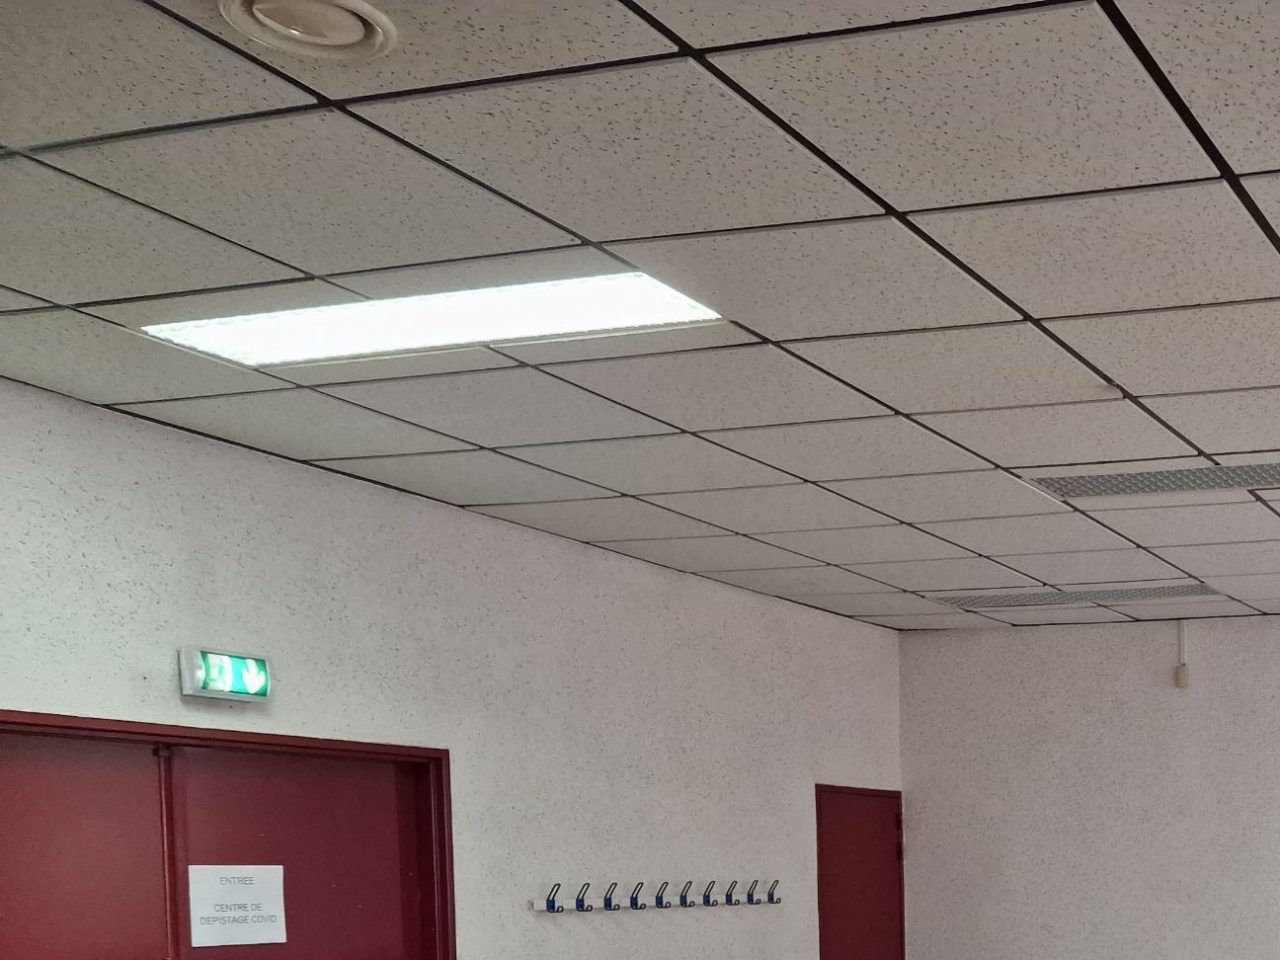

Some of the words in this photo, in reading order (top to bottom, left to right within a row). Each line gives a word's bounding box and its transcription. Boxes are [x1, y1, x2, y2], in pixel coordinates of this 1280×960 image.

[214, 903, 249, 913] CENTRE
[251, 903, 263, 912] DE
[251, 914, 277, 924] COVID
